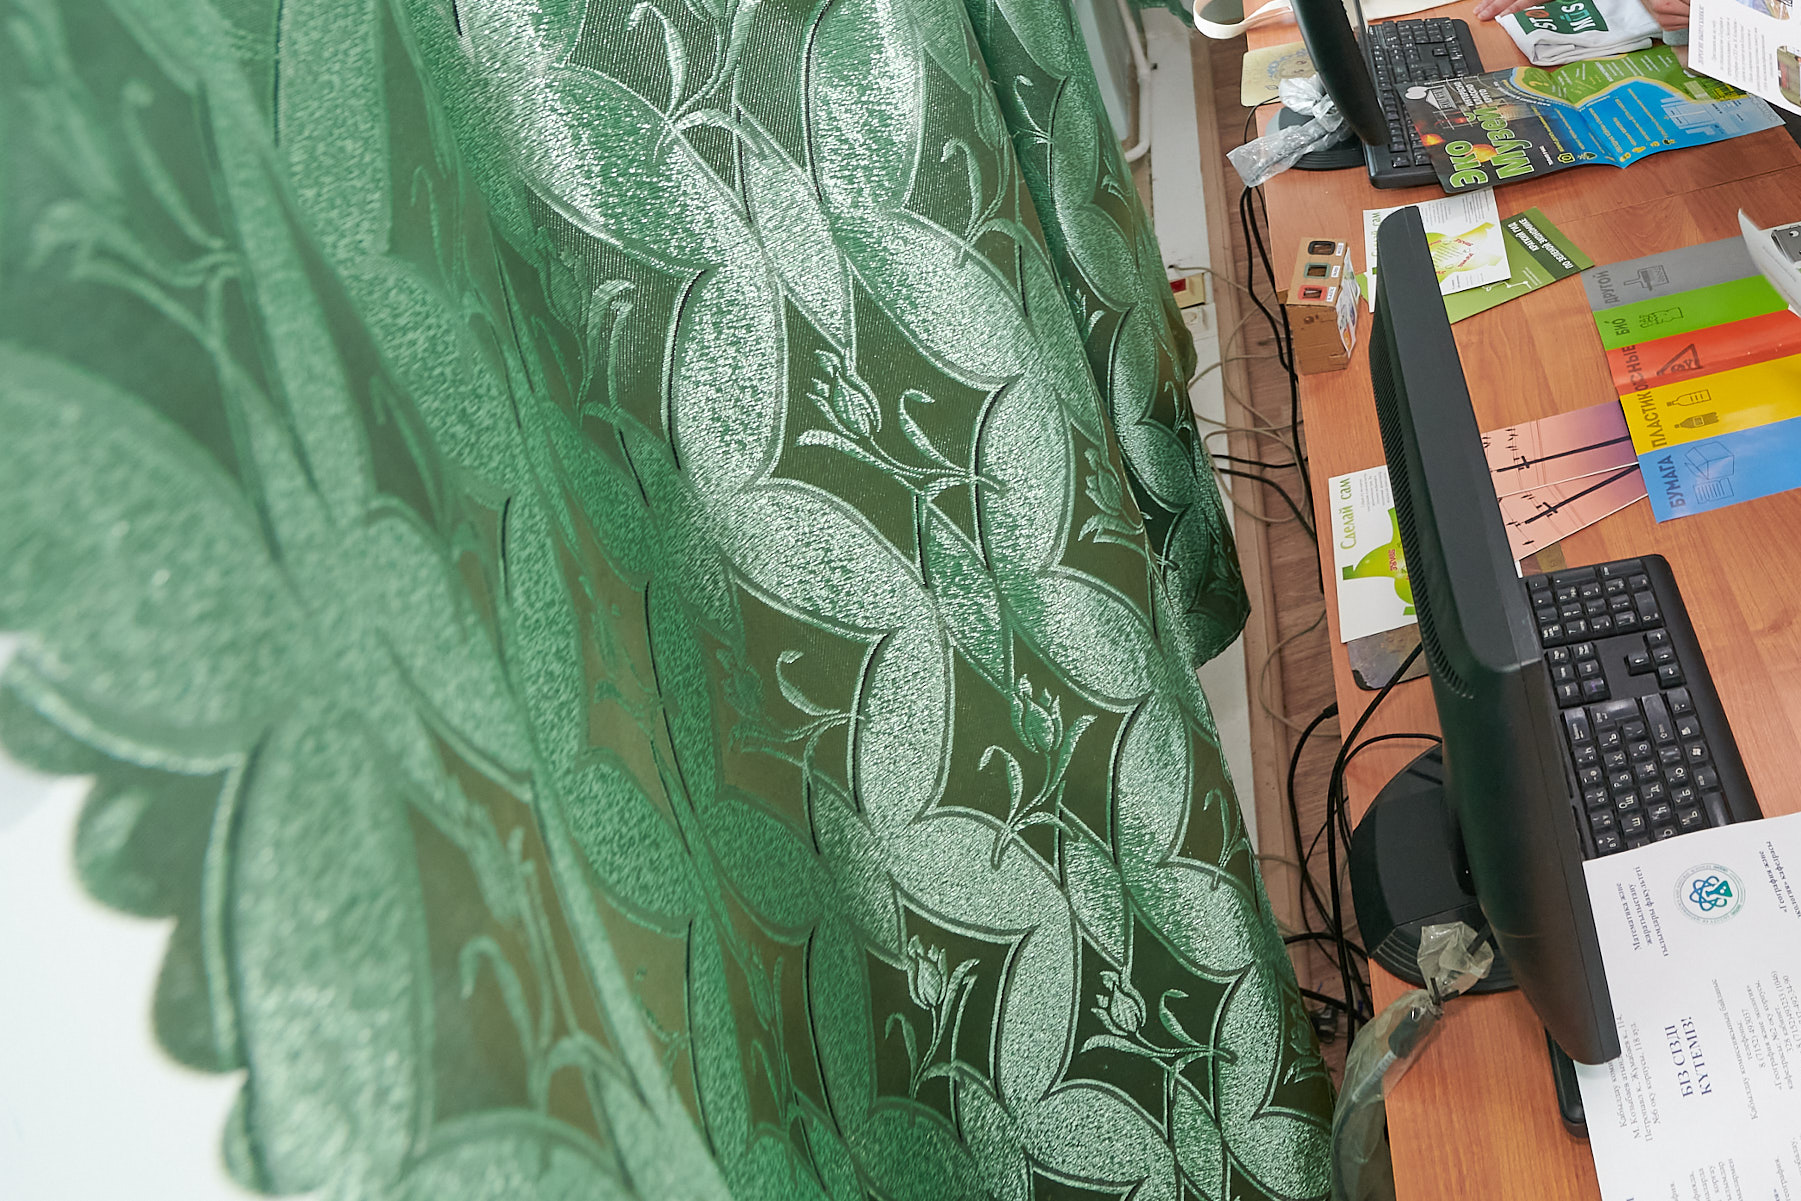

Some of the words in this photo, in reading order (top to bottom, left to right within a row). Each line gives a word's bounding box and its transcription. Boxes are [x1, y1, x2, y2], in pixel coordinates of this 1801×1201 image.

[1461, 105, 1536, 179] Музей
[1442, 139, 1491, 188] Эко
[1507, 219, 1521, 234] ГИД
[1515, 228, 1540, 254] КРАТКИЙ
[1517, 215, 1548, 245] ЭКОНОМИКЕ
[1561, 259, 1573, 271] ПО
[1592, 270, 1620, 305] ДРУГОЙ
[1635, 391, 1668, 448] ПЛАСТИК
[1340, 477, 1352, 500] сам
[1657, 455, 1687, 508] БУМАГА
[1340, 505, 1357, 550] Сделай
[1764, 839, 1787, 880] кафедрасы
[1615, 881, 1626, 901] және
[1765, 868, 1790, 913] «География
[1621, 901, 1642, 951] Математика
[1741, 1007, 1756, 1034] 493037
[1768, 1026, 1779, 1041] №2
[1632, 1037, 1643, 1051] 118
[1664, 1024, 1686, 1067] СІЗДІ
[1750, 1034, 1765, 1061] (7152)
[1783, 1037, 1794, 1053] 328
[1676, 1069, 1694, 1097] БІЗ
